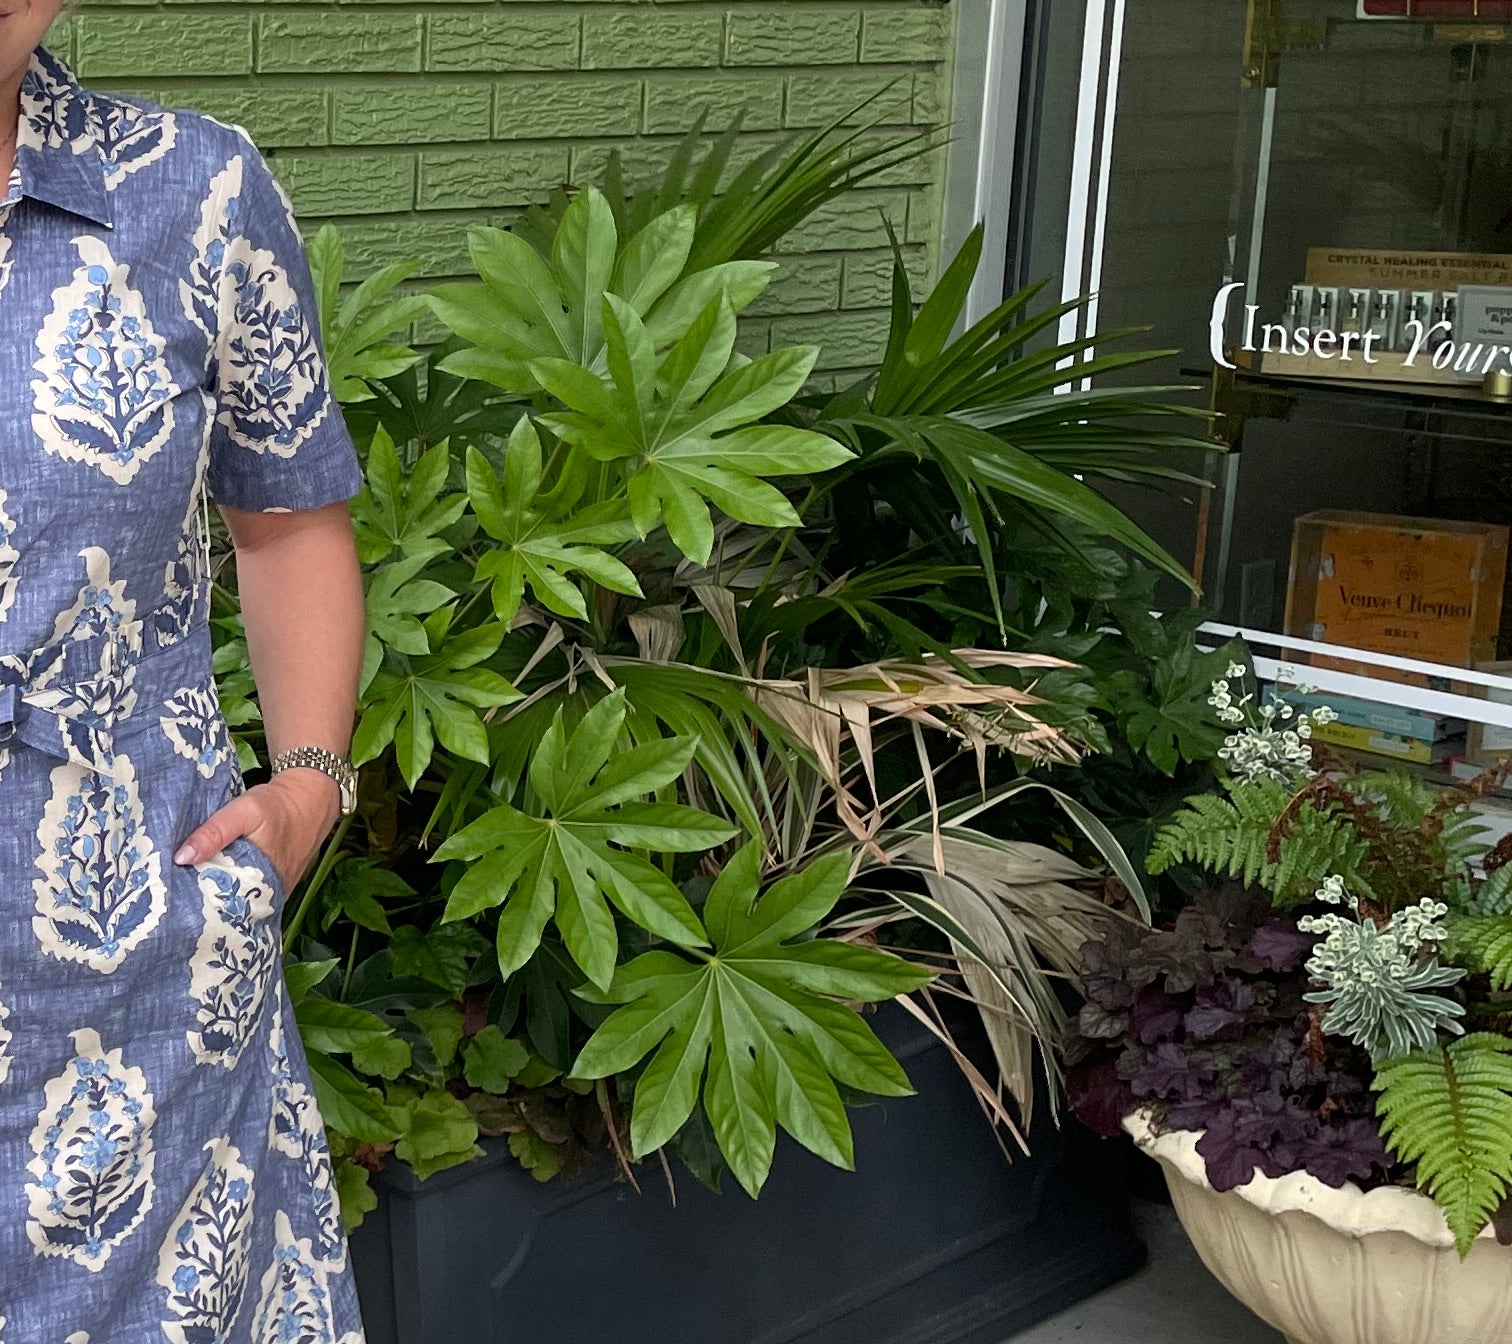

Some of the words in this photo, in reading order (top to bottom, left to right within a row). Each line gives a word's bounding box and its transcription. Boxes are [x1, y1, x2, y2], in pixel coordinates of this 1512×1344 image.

[1327, 255, 1380, 265] CRYSTAL
[1338, 583, 1391, 609] Veuve
[1384, 627, 1420, 640] BRUT
